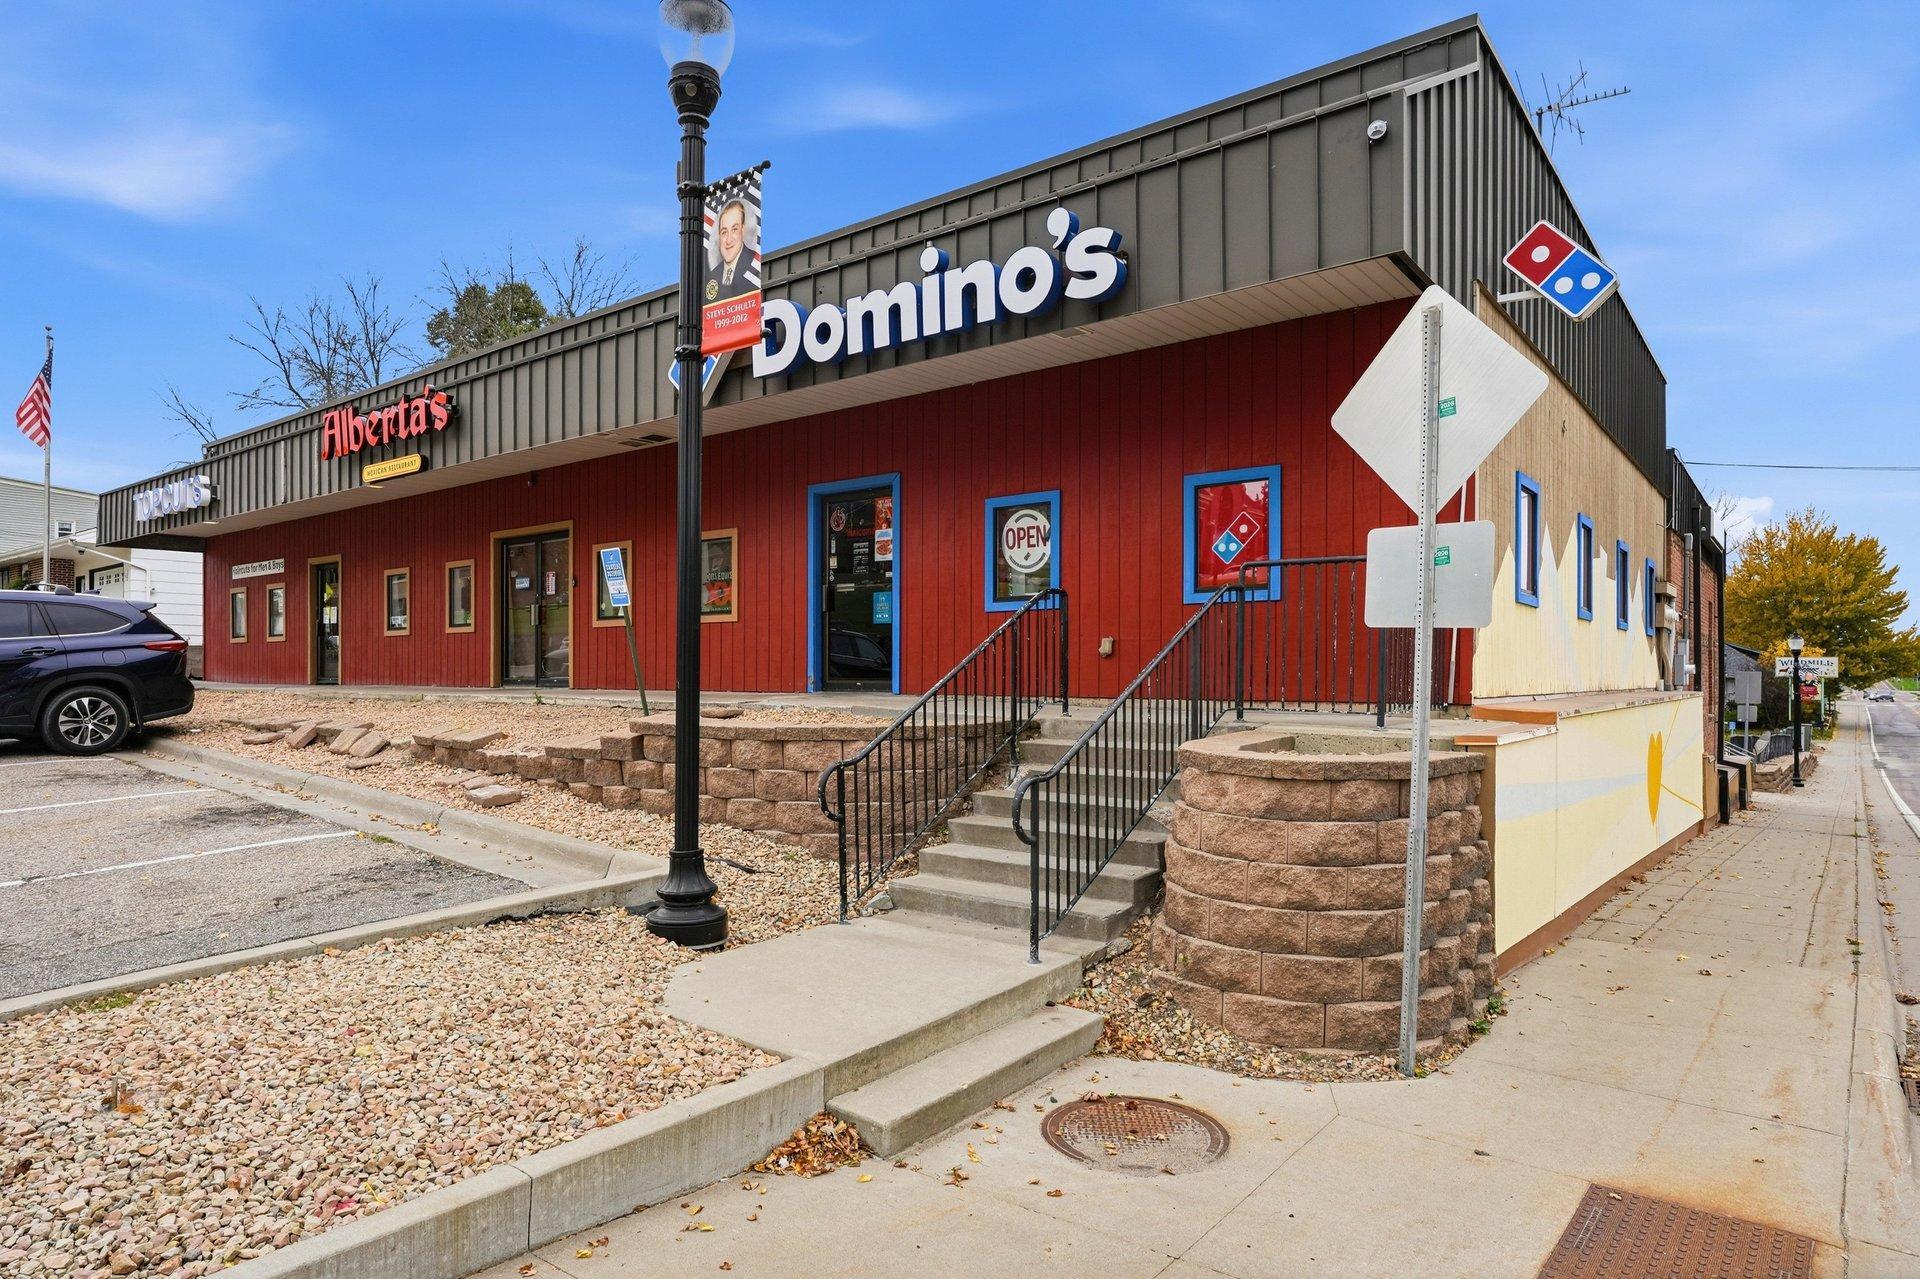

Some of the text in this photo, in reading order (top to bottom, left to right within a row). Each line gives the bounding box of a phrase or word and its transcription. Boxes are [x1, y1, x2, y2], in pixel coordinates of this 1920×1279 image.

[753, 207, 1122, 378] Domino's
[706, 299, 757, 319] STEVE SCHULTZ
[714, 313, 749, 329] 1999-2012
[322, 384, 449, 461] Alberta's
[388, 459, 417, 472] RESTAURANT
[1005, 524, 1047, 550] OPEN
[250, 563, 258, 573] for
[258, 562, 268, 572] Men
[272, 560, 284, 571] Boys
